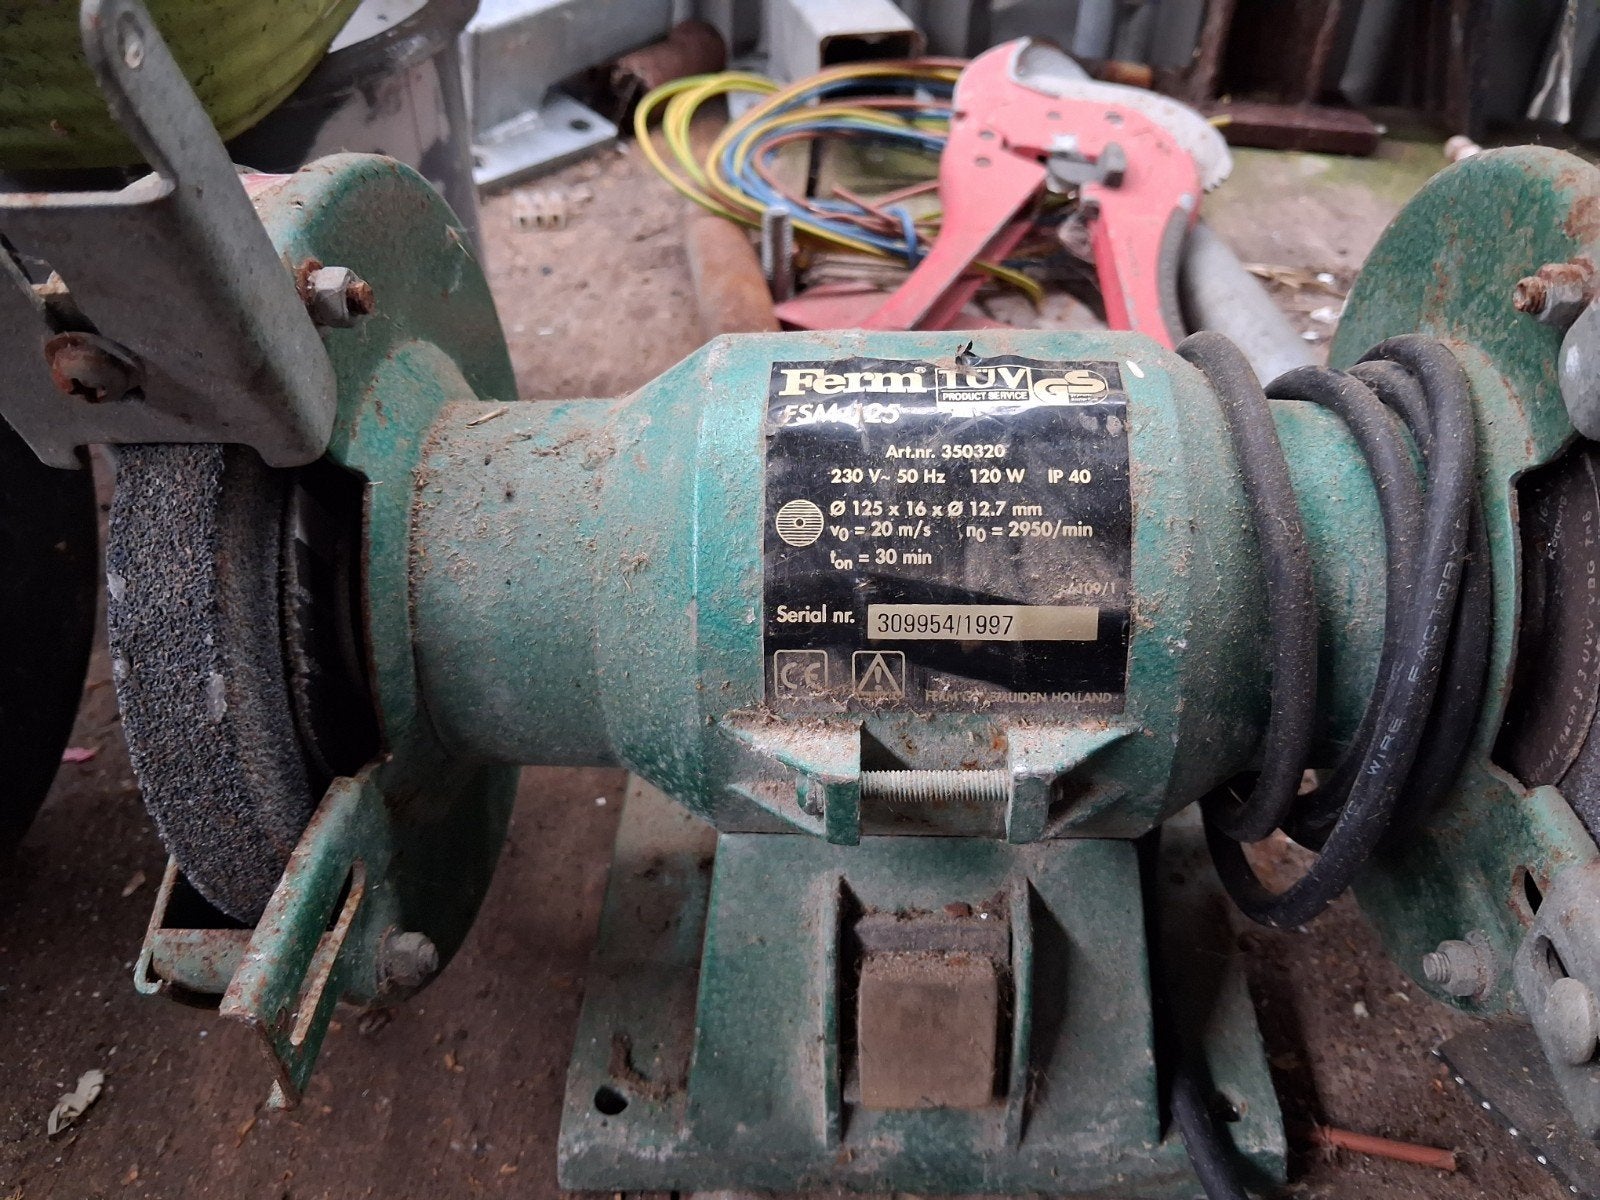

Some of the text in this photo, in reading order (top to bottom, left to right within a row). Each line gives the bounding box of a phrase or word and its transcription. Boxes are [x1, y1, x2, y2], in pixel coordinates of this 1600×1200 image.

[938, 367, 1027, 389] TÜV
[1034, 369, 1106, 404] GS
[942, 390, 1028, 401] PRODUCT SERVICE
[885, 444, 1007, 459] Art.nr. 350320
[830, 468, 864, 484] 230
[896, 468, 919, 484] 50
[923, 468, 946, 484] Hz
[970, 468, 1001, 484] 120
[1005, 468, 1025, 484] W
[1047, 469, 1064, 484] IP
[1068, 468, 1092, 484] 40
[852, 500, 883, 516] 125
[888, 505, 900, 516] x
[906, 500, 927, 517] 16
[931, 505, 943, 517] x
[969, 500, 1007, 517] 12.7
[1012, 504, 1043, 516] mm
[854, 526, 866, 535] =
[870, 520, 893, 537] 20
[898, 519, 931, 539] m/s
[991, 526, 1003, 536] =
[1008, 519, 1093, 539] 2950/min
[858, 554, 870, 563] =
[875, 548, 898, 565] 30
[902, 548, 933, 565] min
[776, 603, 855, 623] Serial nr.
[877, 612, 1014, 635] 309954/1997
[780, 662, 821, 690] CE
[1051, 692, 1113, 703] HOLLAND
[1366, 718, 1403, 775] WIRE
